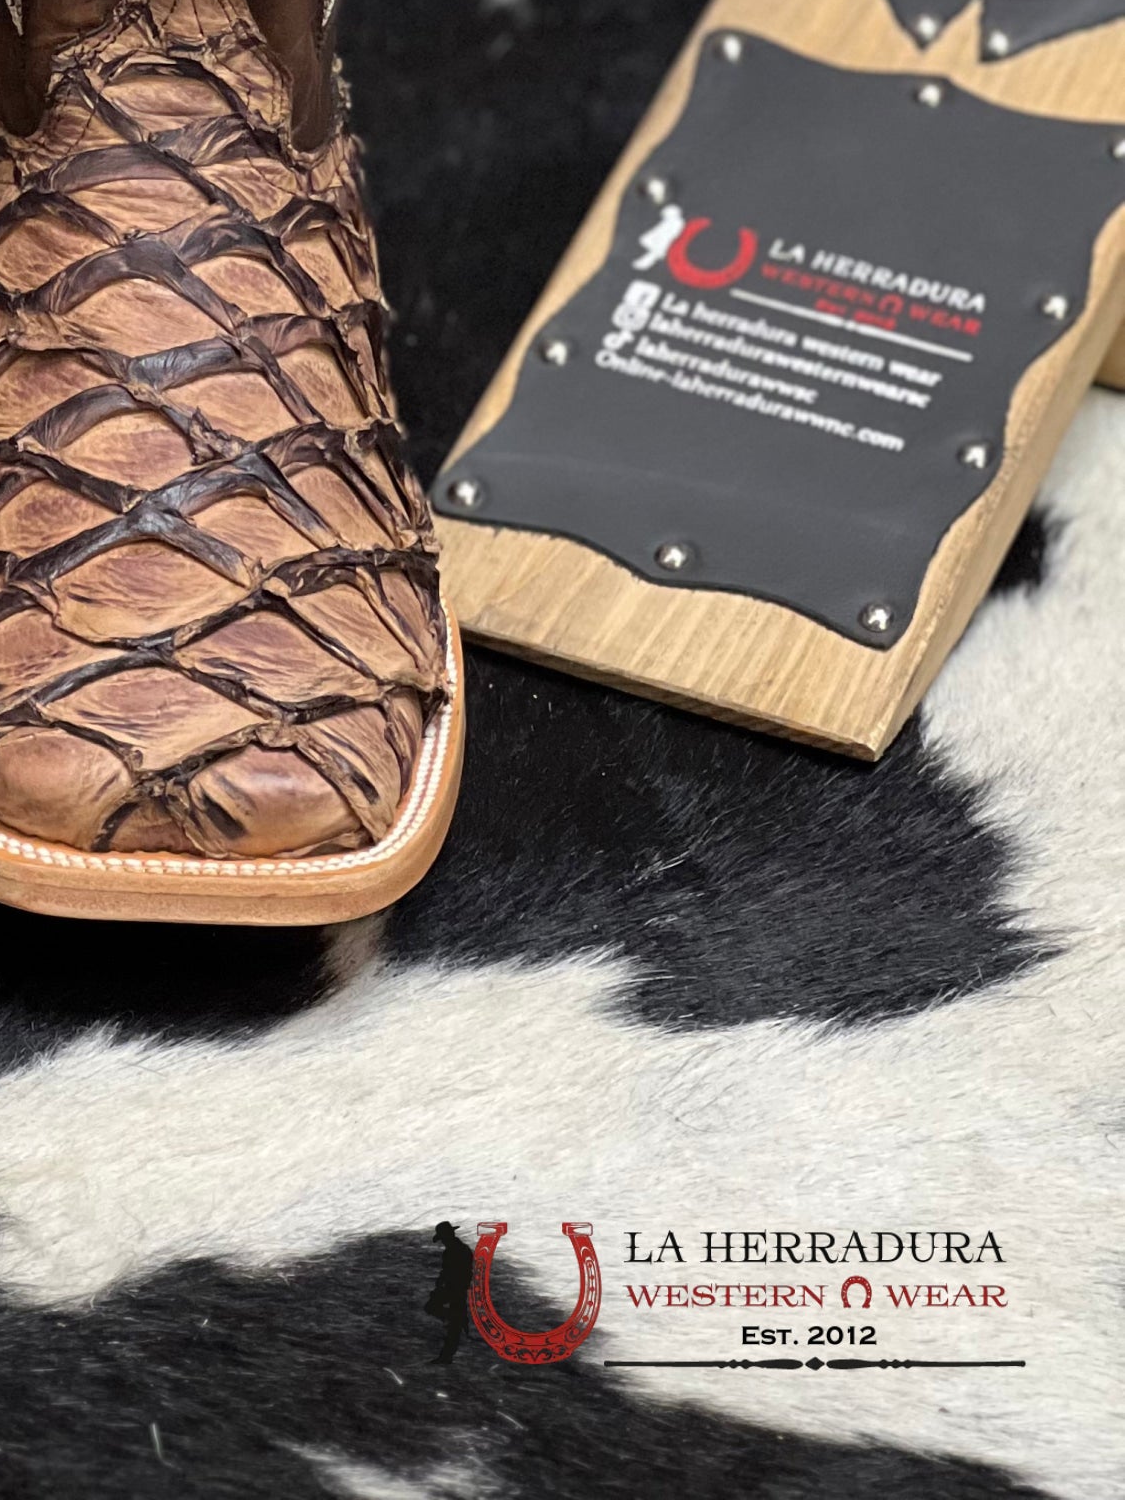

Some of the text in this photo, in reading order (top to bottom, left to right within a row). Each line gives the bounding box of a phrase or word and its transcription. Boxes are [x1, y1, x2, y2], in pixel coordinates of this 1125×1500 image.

[761, 263, 875, 306] WESTERN
[909, 304, 982, 336] WEAR
[768, 238, 986, 313] LA HERRADURA
[660, 292, 690, 317] La
[691, 301, 798, 348] herradura
[801, 336, 885, 372] western
[888, 360, 943, 388] wear
